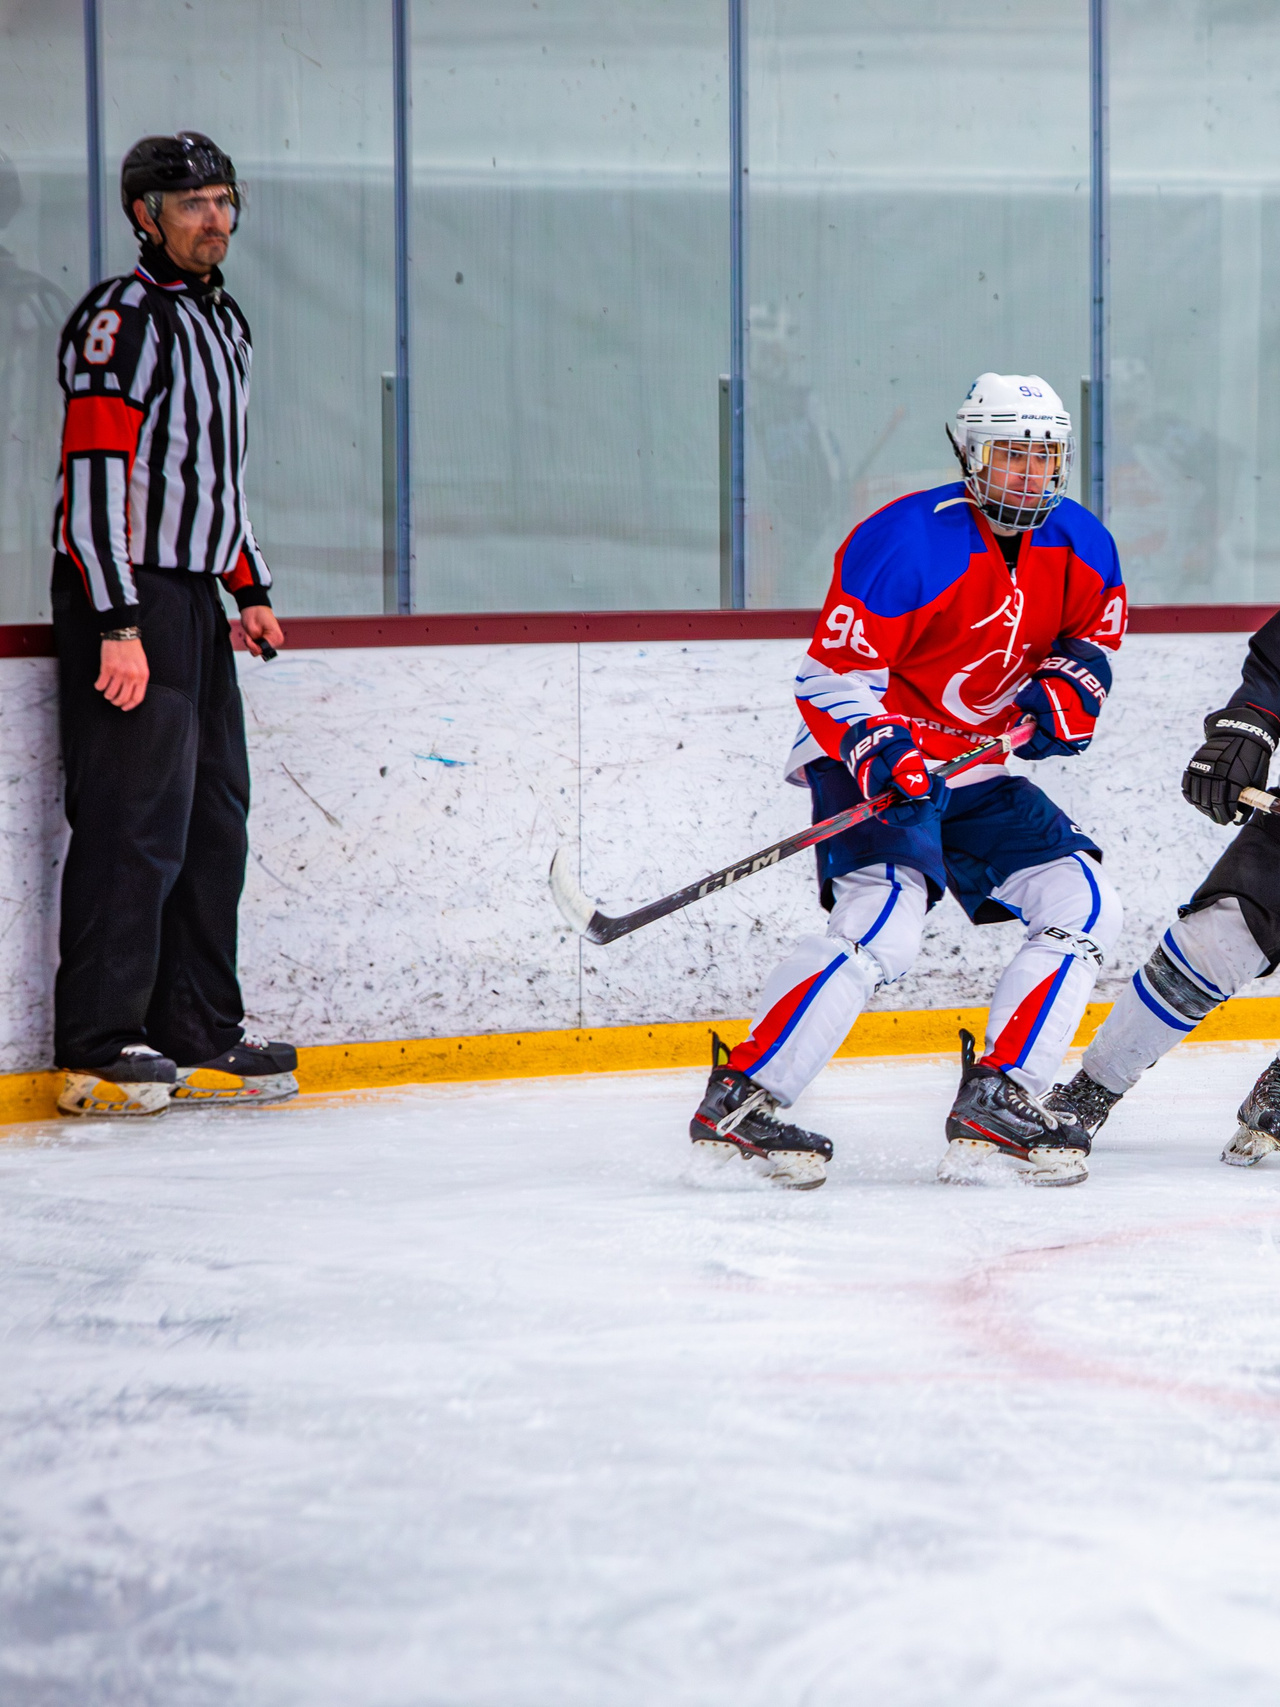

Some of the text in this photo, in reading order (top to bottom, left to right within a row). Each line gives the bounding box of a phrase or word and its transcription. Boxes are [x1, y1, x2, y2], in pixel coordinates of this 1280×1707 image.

[84, 310, 121, 364] 8
[821, 604, 879, 659] 98
[1094, 596, 1128, 636] 9
[698, 848, 781, 898] CCM
